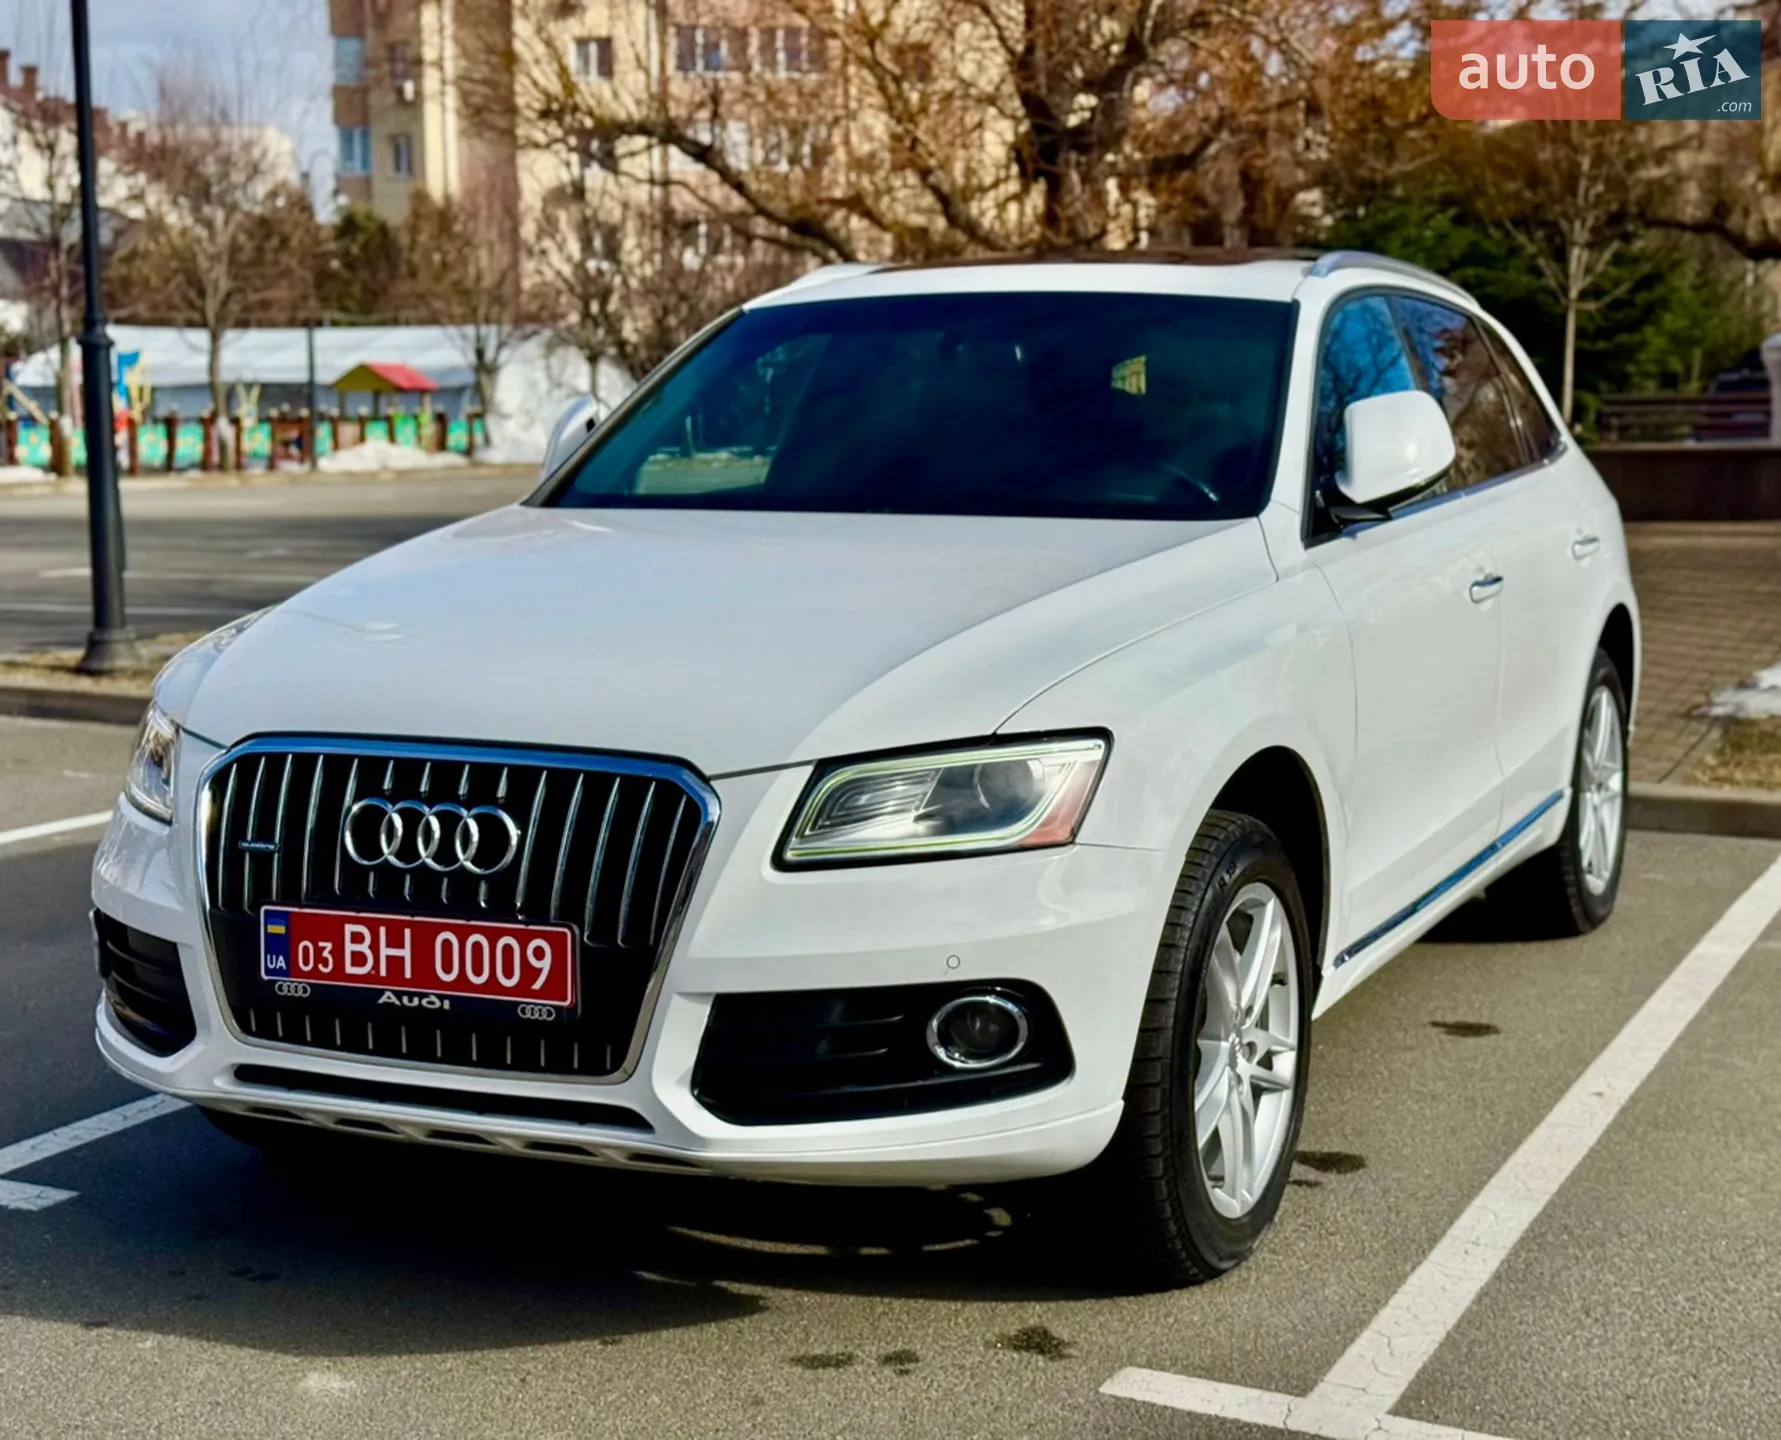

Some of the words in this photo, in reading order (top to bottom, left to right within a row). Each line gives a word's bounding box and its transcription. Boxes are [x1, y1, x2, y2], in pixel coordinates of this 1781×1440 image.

[267, 954, 286, 970] UA
[298, 940, 333, 973] 03
[344, 924, 412, 979] BH
[434, 931, 552, 990] 0009
